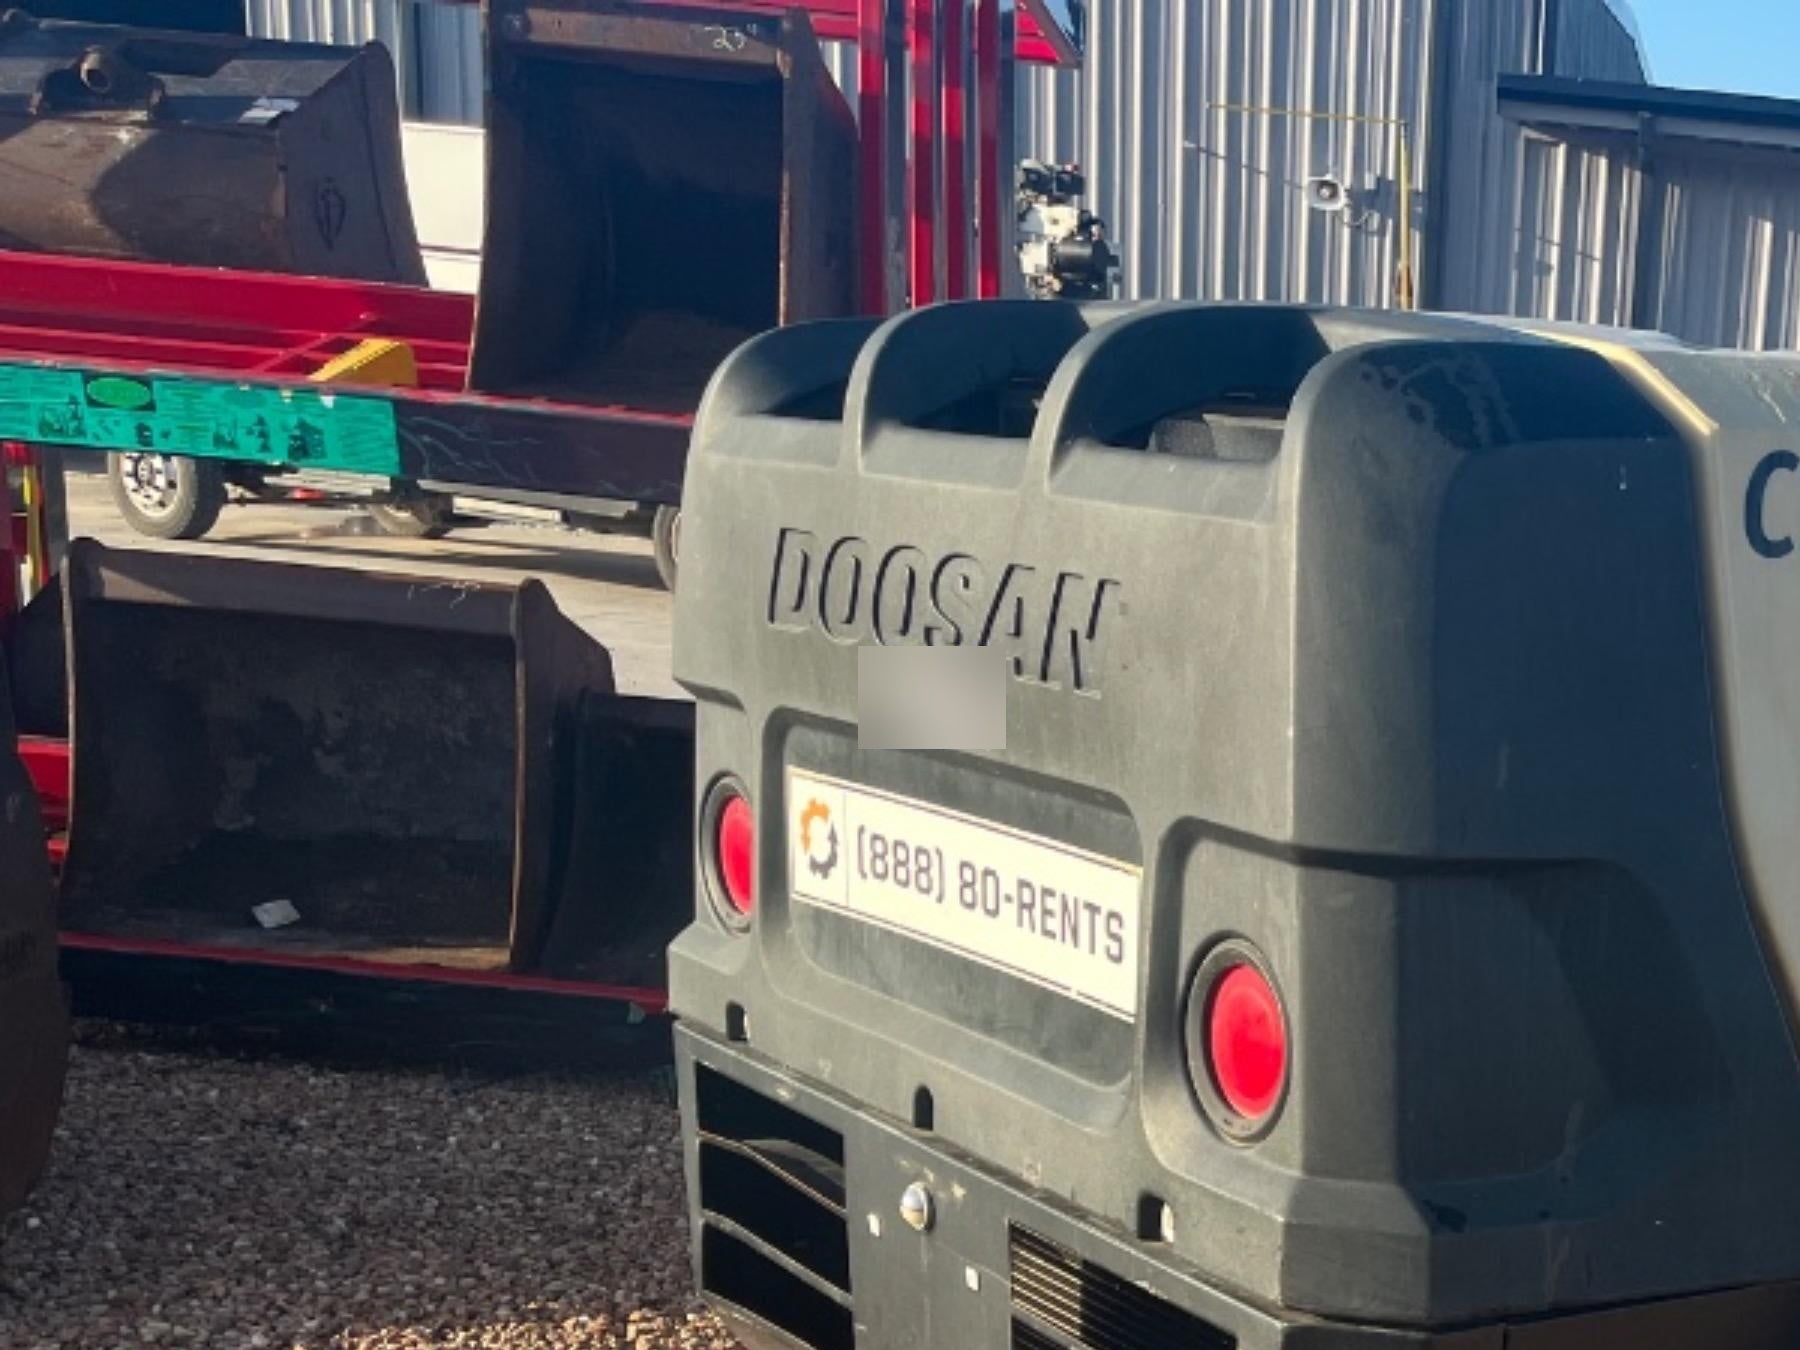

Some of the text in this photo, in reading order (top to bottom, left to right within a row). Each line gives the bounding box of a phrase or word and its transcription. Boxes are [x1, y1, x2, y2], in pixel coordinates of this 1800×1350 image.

[767, 526, 1121, 699] DOOSAN
[856, 824, 1124, 964] (888) 80-RENTS
